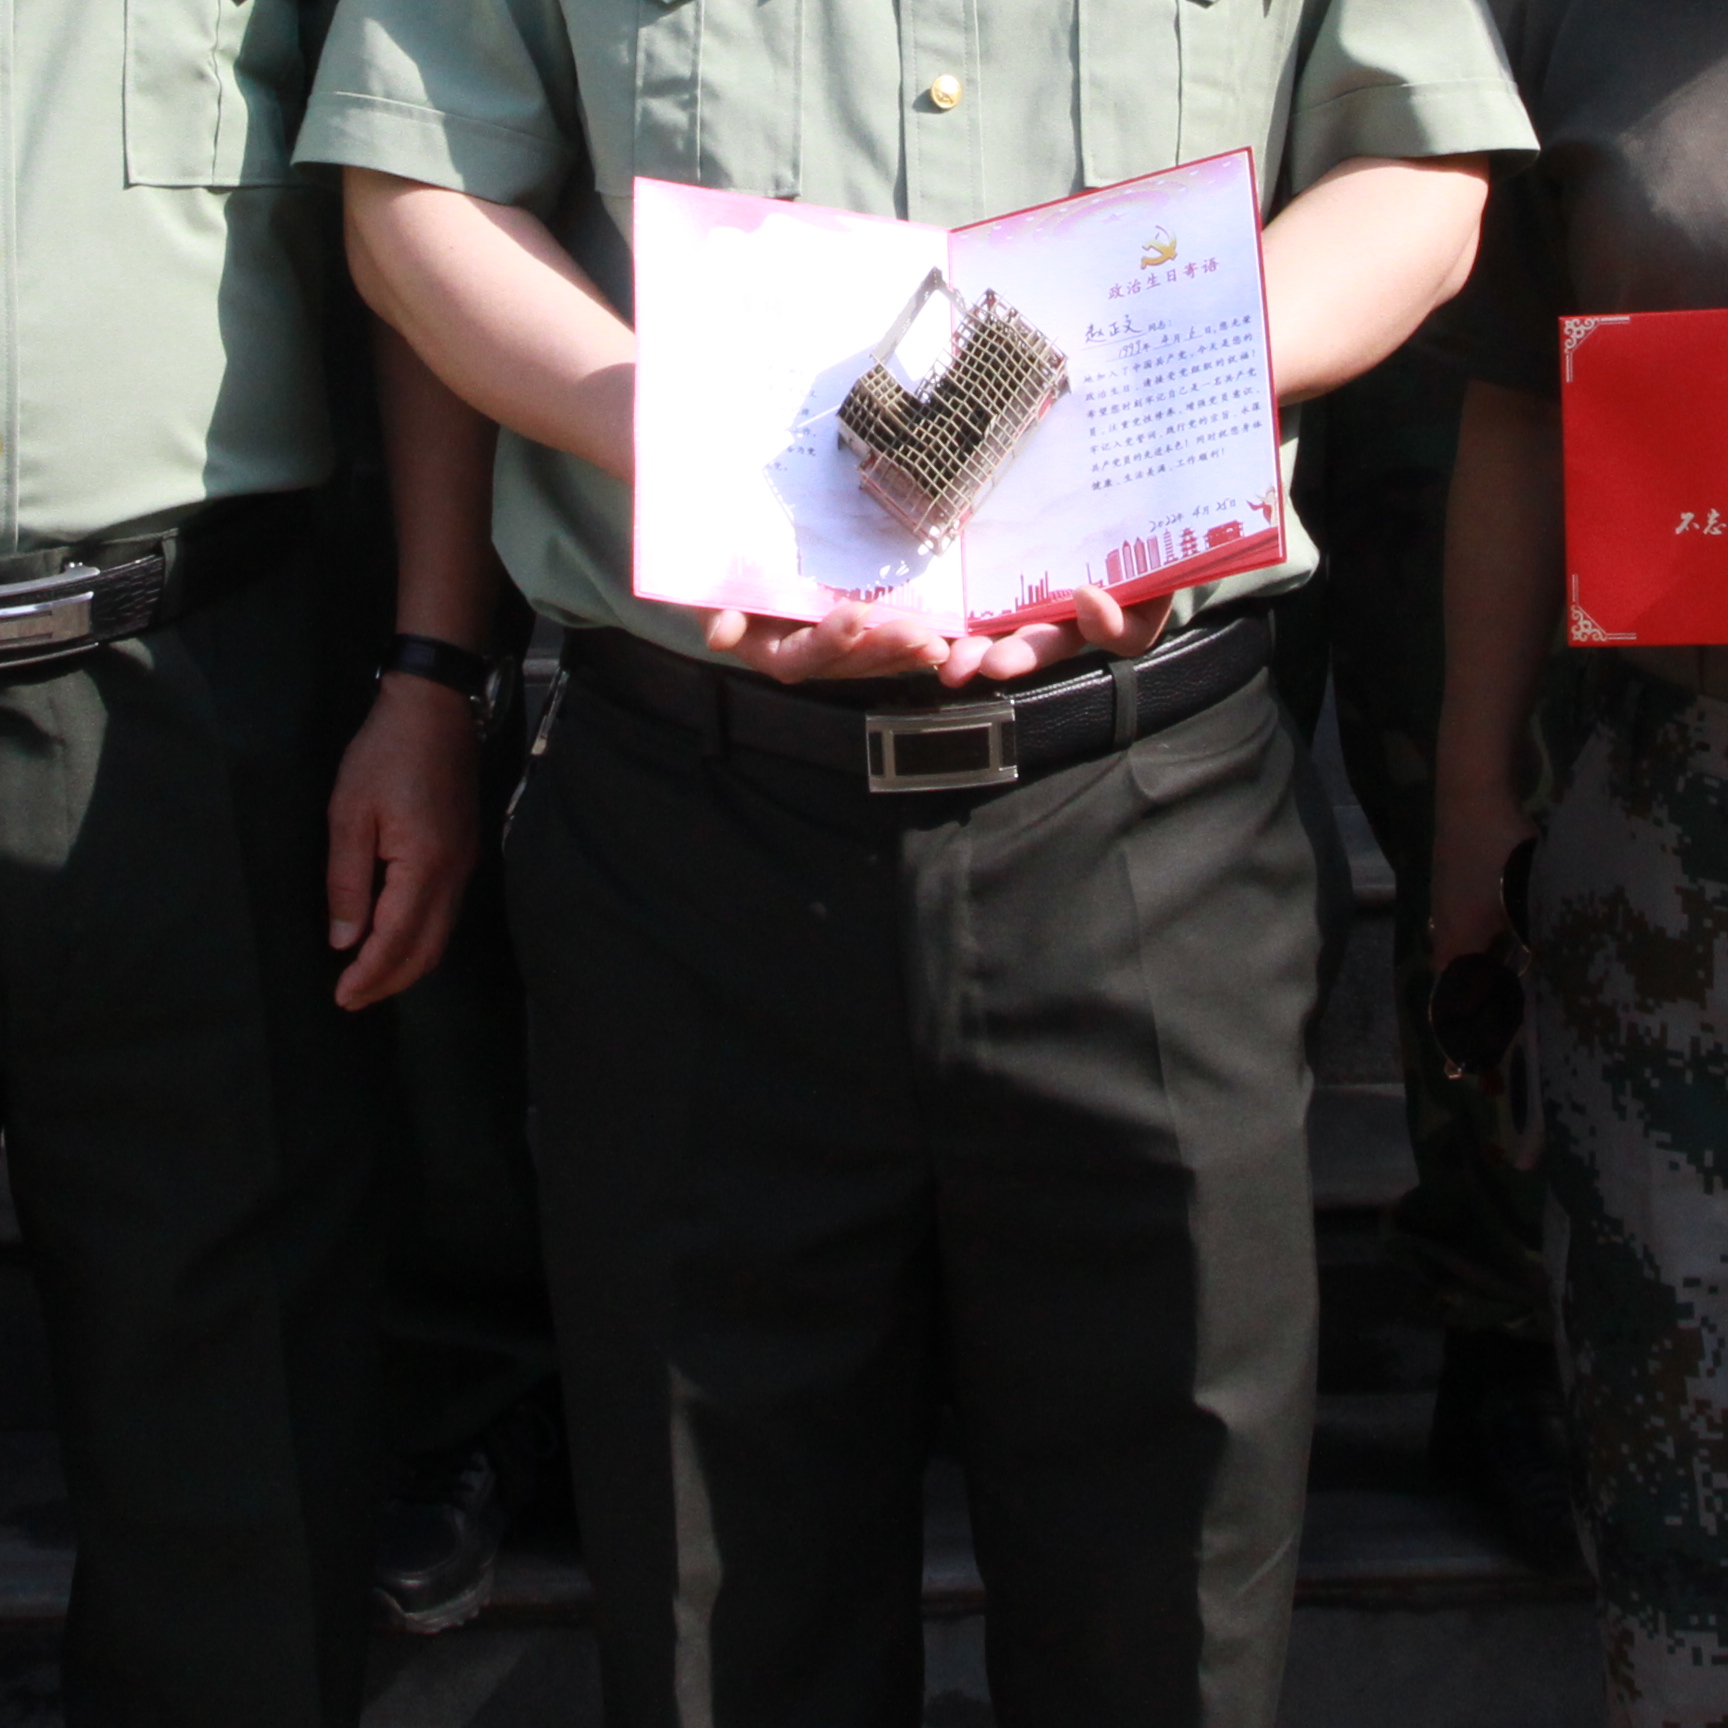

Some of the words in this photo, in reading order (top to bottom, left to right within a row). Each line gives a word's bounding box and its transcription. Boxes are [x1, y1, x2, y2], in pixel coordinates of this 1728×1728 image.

[1108, 257, 1219, 300] 政治生日寄语
